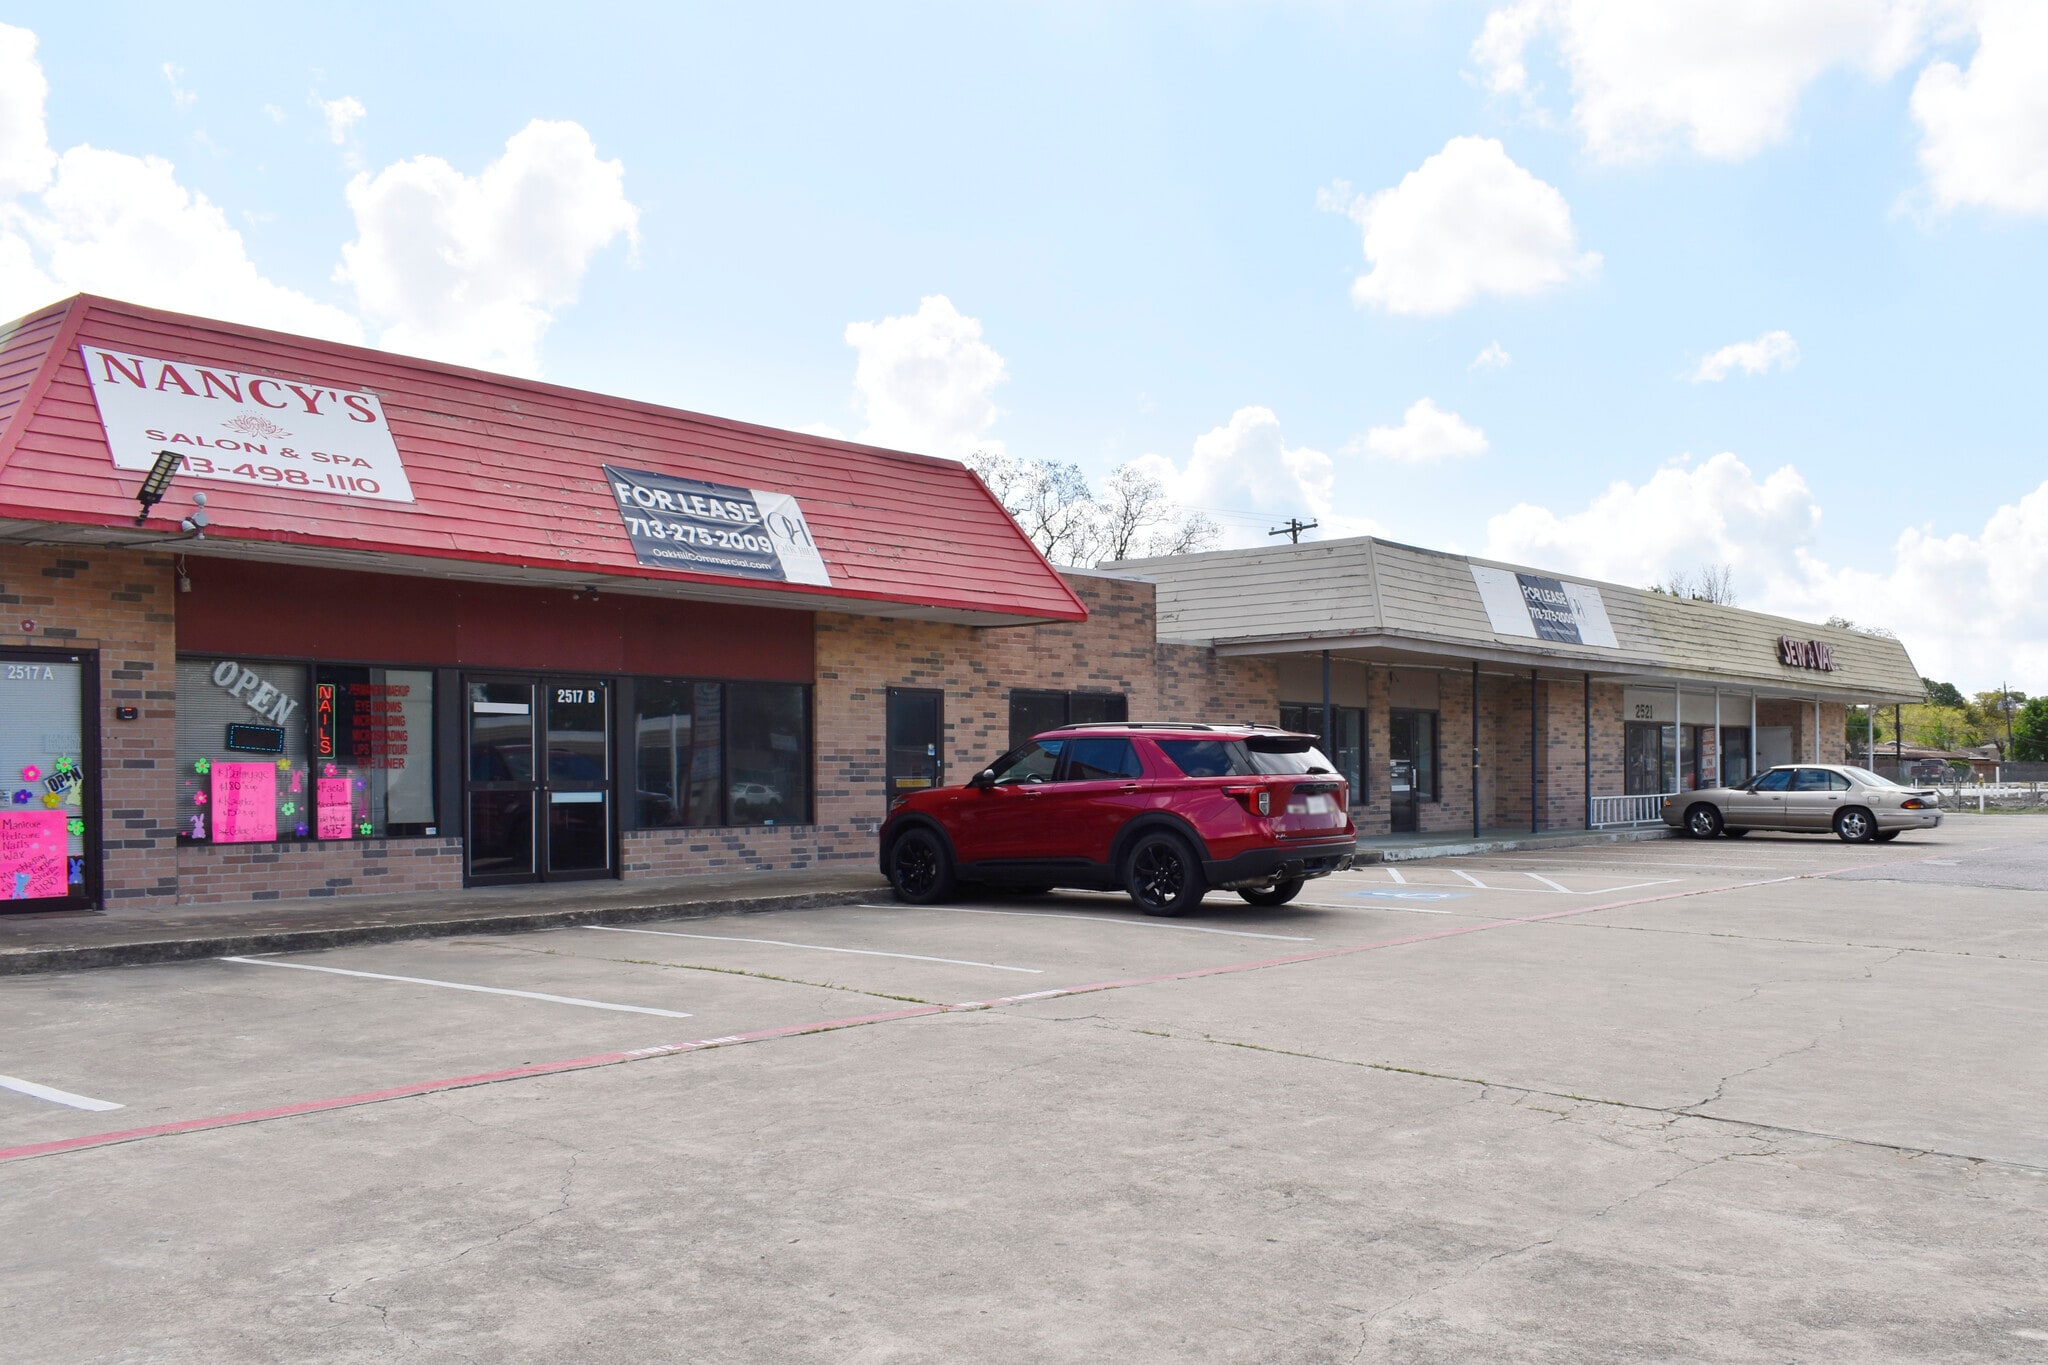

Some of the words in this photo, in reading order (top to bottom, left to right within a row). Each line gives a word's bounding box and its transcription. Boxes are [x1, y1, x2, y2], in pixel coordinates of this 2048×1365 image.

[96, 352, 376, 423] NANCY'S
[145, 429, 268, 455] SALON
[280, 447, 301, 460] &
[311, 452, 373, 469] SPA
[151, 451, 380, 493] 13-498-1110
[614, 482, 677, 511] FOR
[677, 493, 761, 523] LEASE
[624, 517, 773, 554] 713-275-2009
[652, 548, 771, 570] OakHillCommercial.com
[1521, 585, 1542, 602] FOR
[1540, 588, 1568, 605] LEASE
[1780, 635, 1806, 667] SEW
[1813, 640, 1835, 671] VAC
[7, 665, 40, 680] 2517
[43, 666, 54, 680] A
[214, 661, 299, 726] OPEN
[557, 689, 583, 703] 2517
[587, 690, 596, 704] B
[1635, 704, 1653, 719] 2521
[318, 686, 332, 754] NAILS
[377, 757, 405, 769] LINER
[2, 840, 30, 851] Nails
